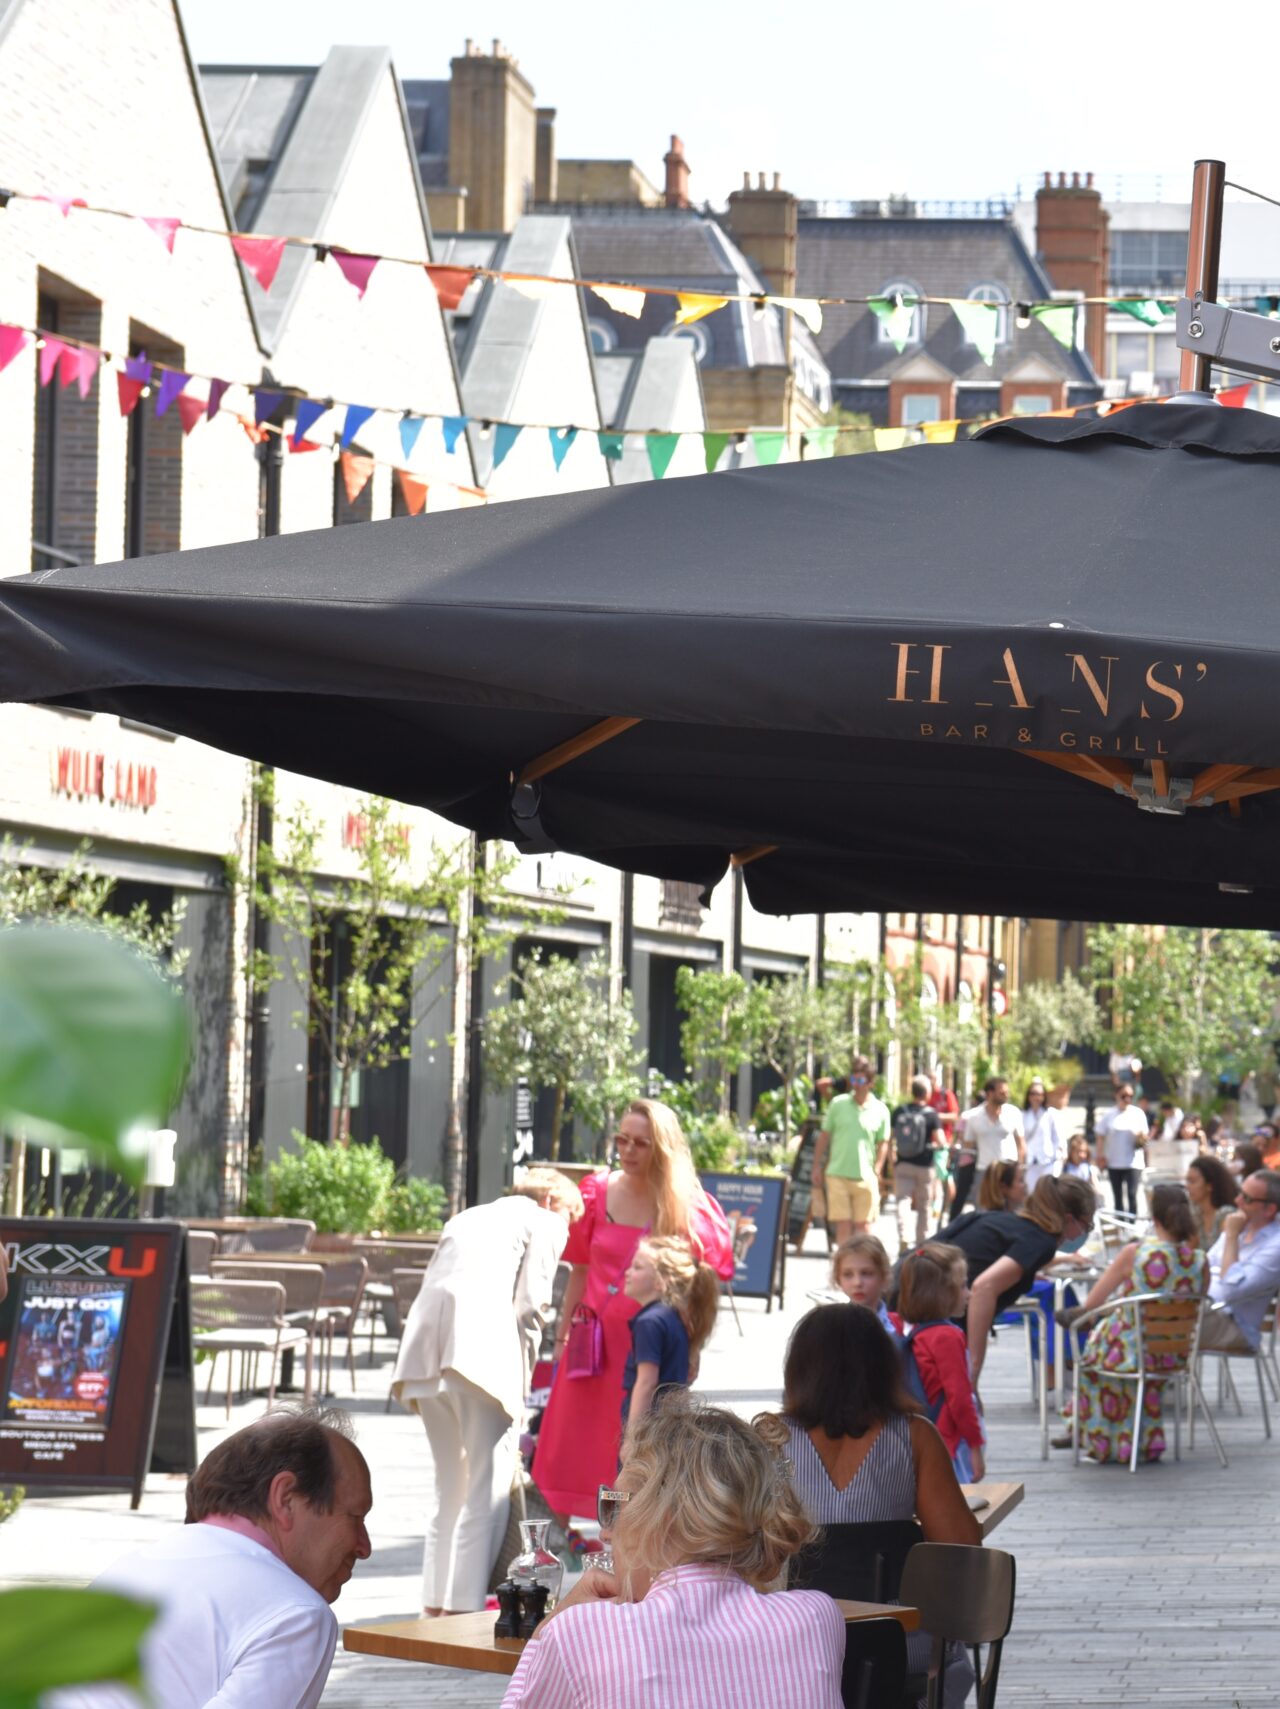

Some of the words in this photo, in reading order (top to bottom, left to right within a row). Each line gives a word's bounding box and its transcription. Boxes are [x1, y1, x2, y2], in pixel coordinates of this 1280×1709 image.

[920, 723, 989, 739] BAR
[1017, 727, 1033, 743] &
[1059, 732, 1169, 754] GRILL
[716, 1182, 741, 1194] HAPPY
[5, 1242, 157, 1277] KXU
[24, 1296, 78, 1310] JUST
[0, 1430, 56, 1440] BOUTIQUE
[58, 1432, 105, 1442] FITNESS
